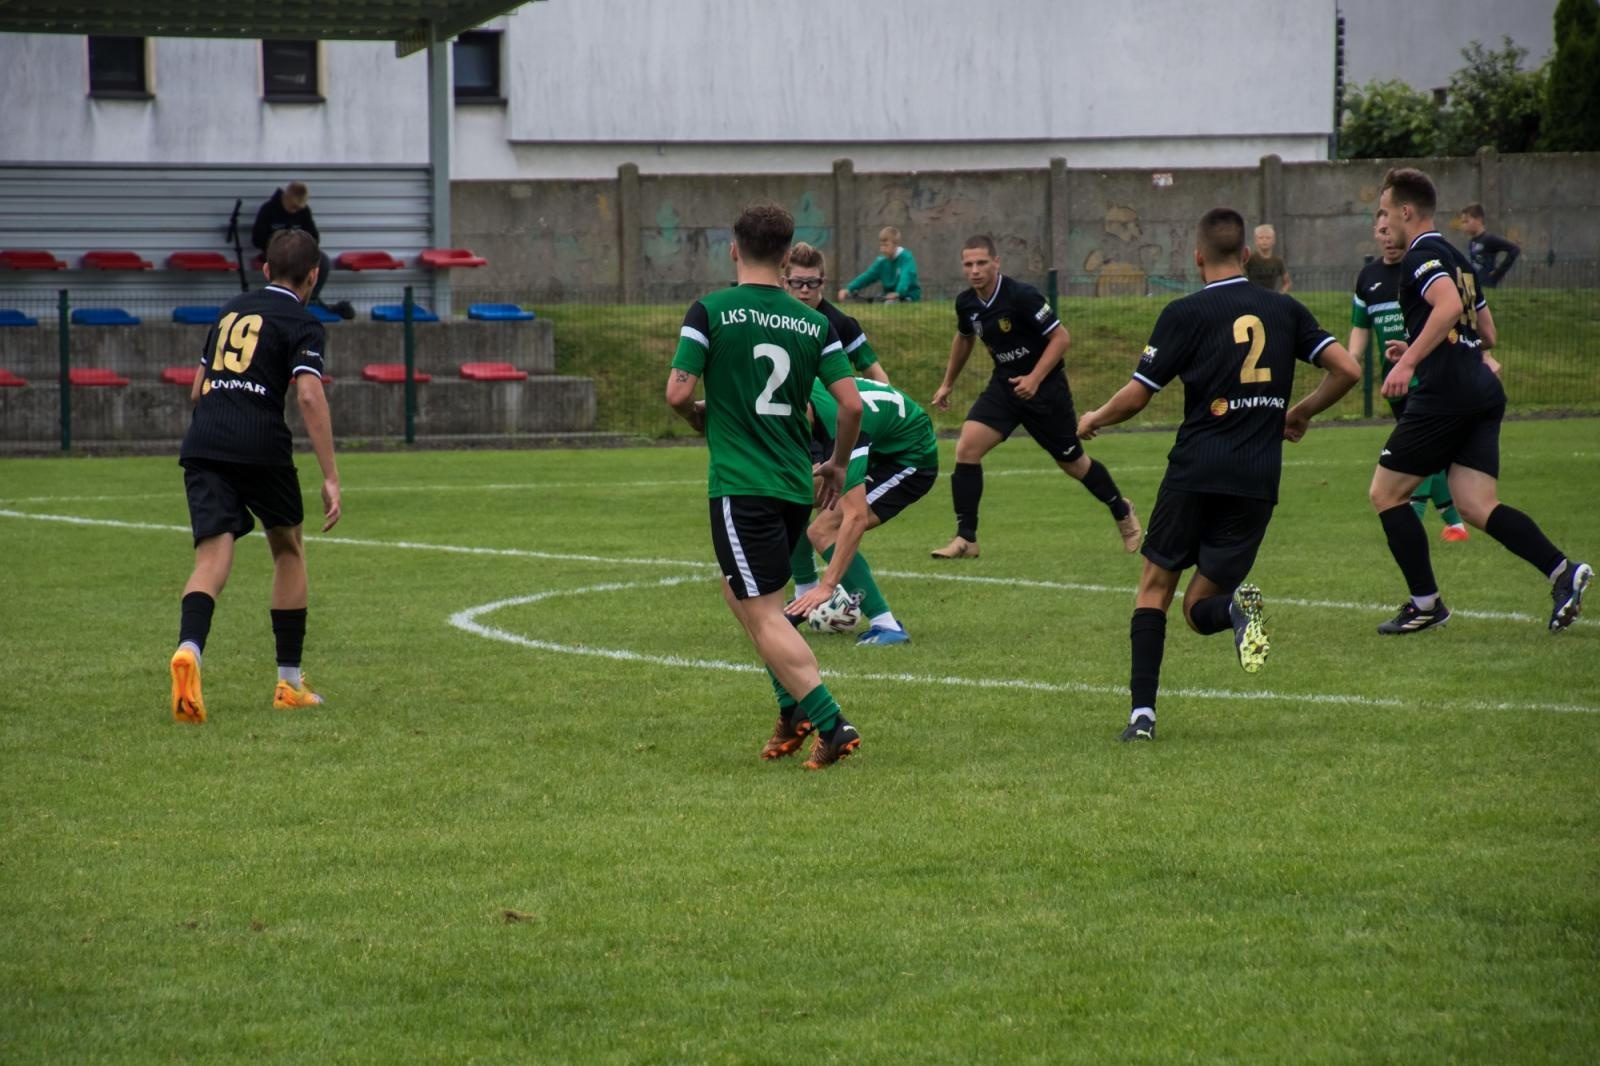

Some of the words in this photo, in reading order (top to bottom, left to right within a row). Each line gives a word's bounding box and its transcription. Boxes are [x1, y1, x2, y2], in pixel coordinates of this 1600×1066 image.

[721, 308, 747, 325] LKS
[748, 308, 821, 338] TWORKÓW
[1385, 312, 1405, 323] SPOR
[212, 311, 263, 373] 19
[1233, 314, 1272, 384] 2
[211, 379, 267, 395] UNIWAR
[753, 343, 792, 416] 2
[1230, 396, 1285, 409] UNIWAR
